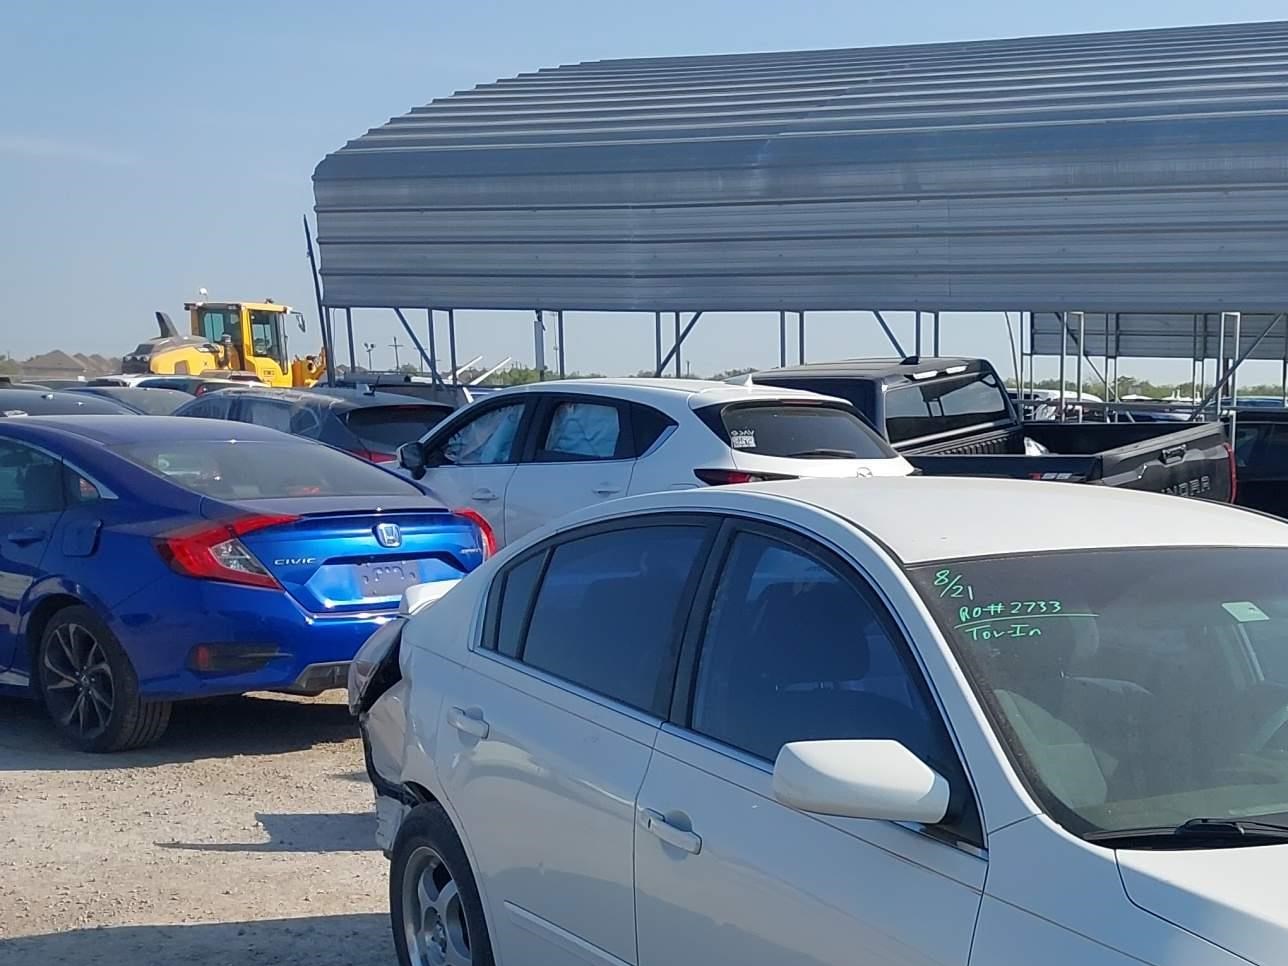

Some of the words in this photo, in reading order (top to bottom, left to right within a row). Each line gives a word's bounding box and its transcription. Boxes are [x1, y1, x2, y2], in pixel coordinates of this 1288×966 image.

[274, 557, 316, 566] CIVIC
[933, 569, 974, 600] 8/21
[1010, 601, 1062, 614] 2733
